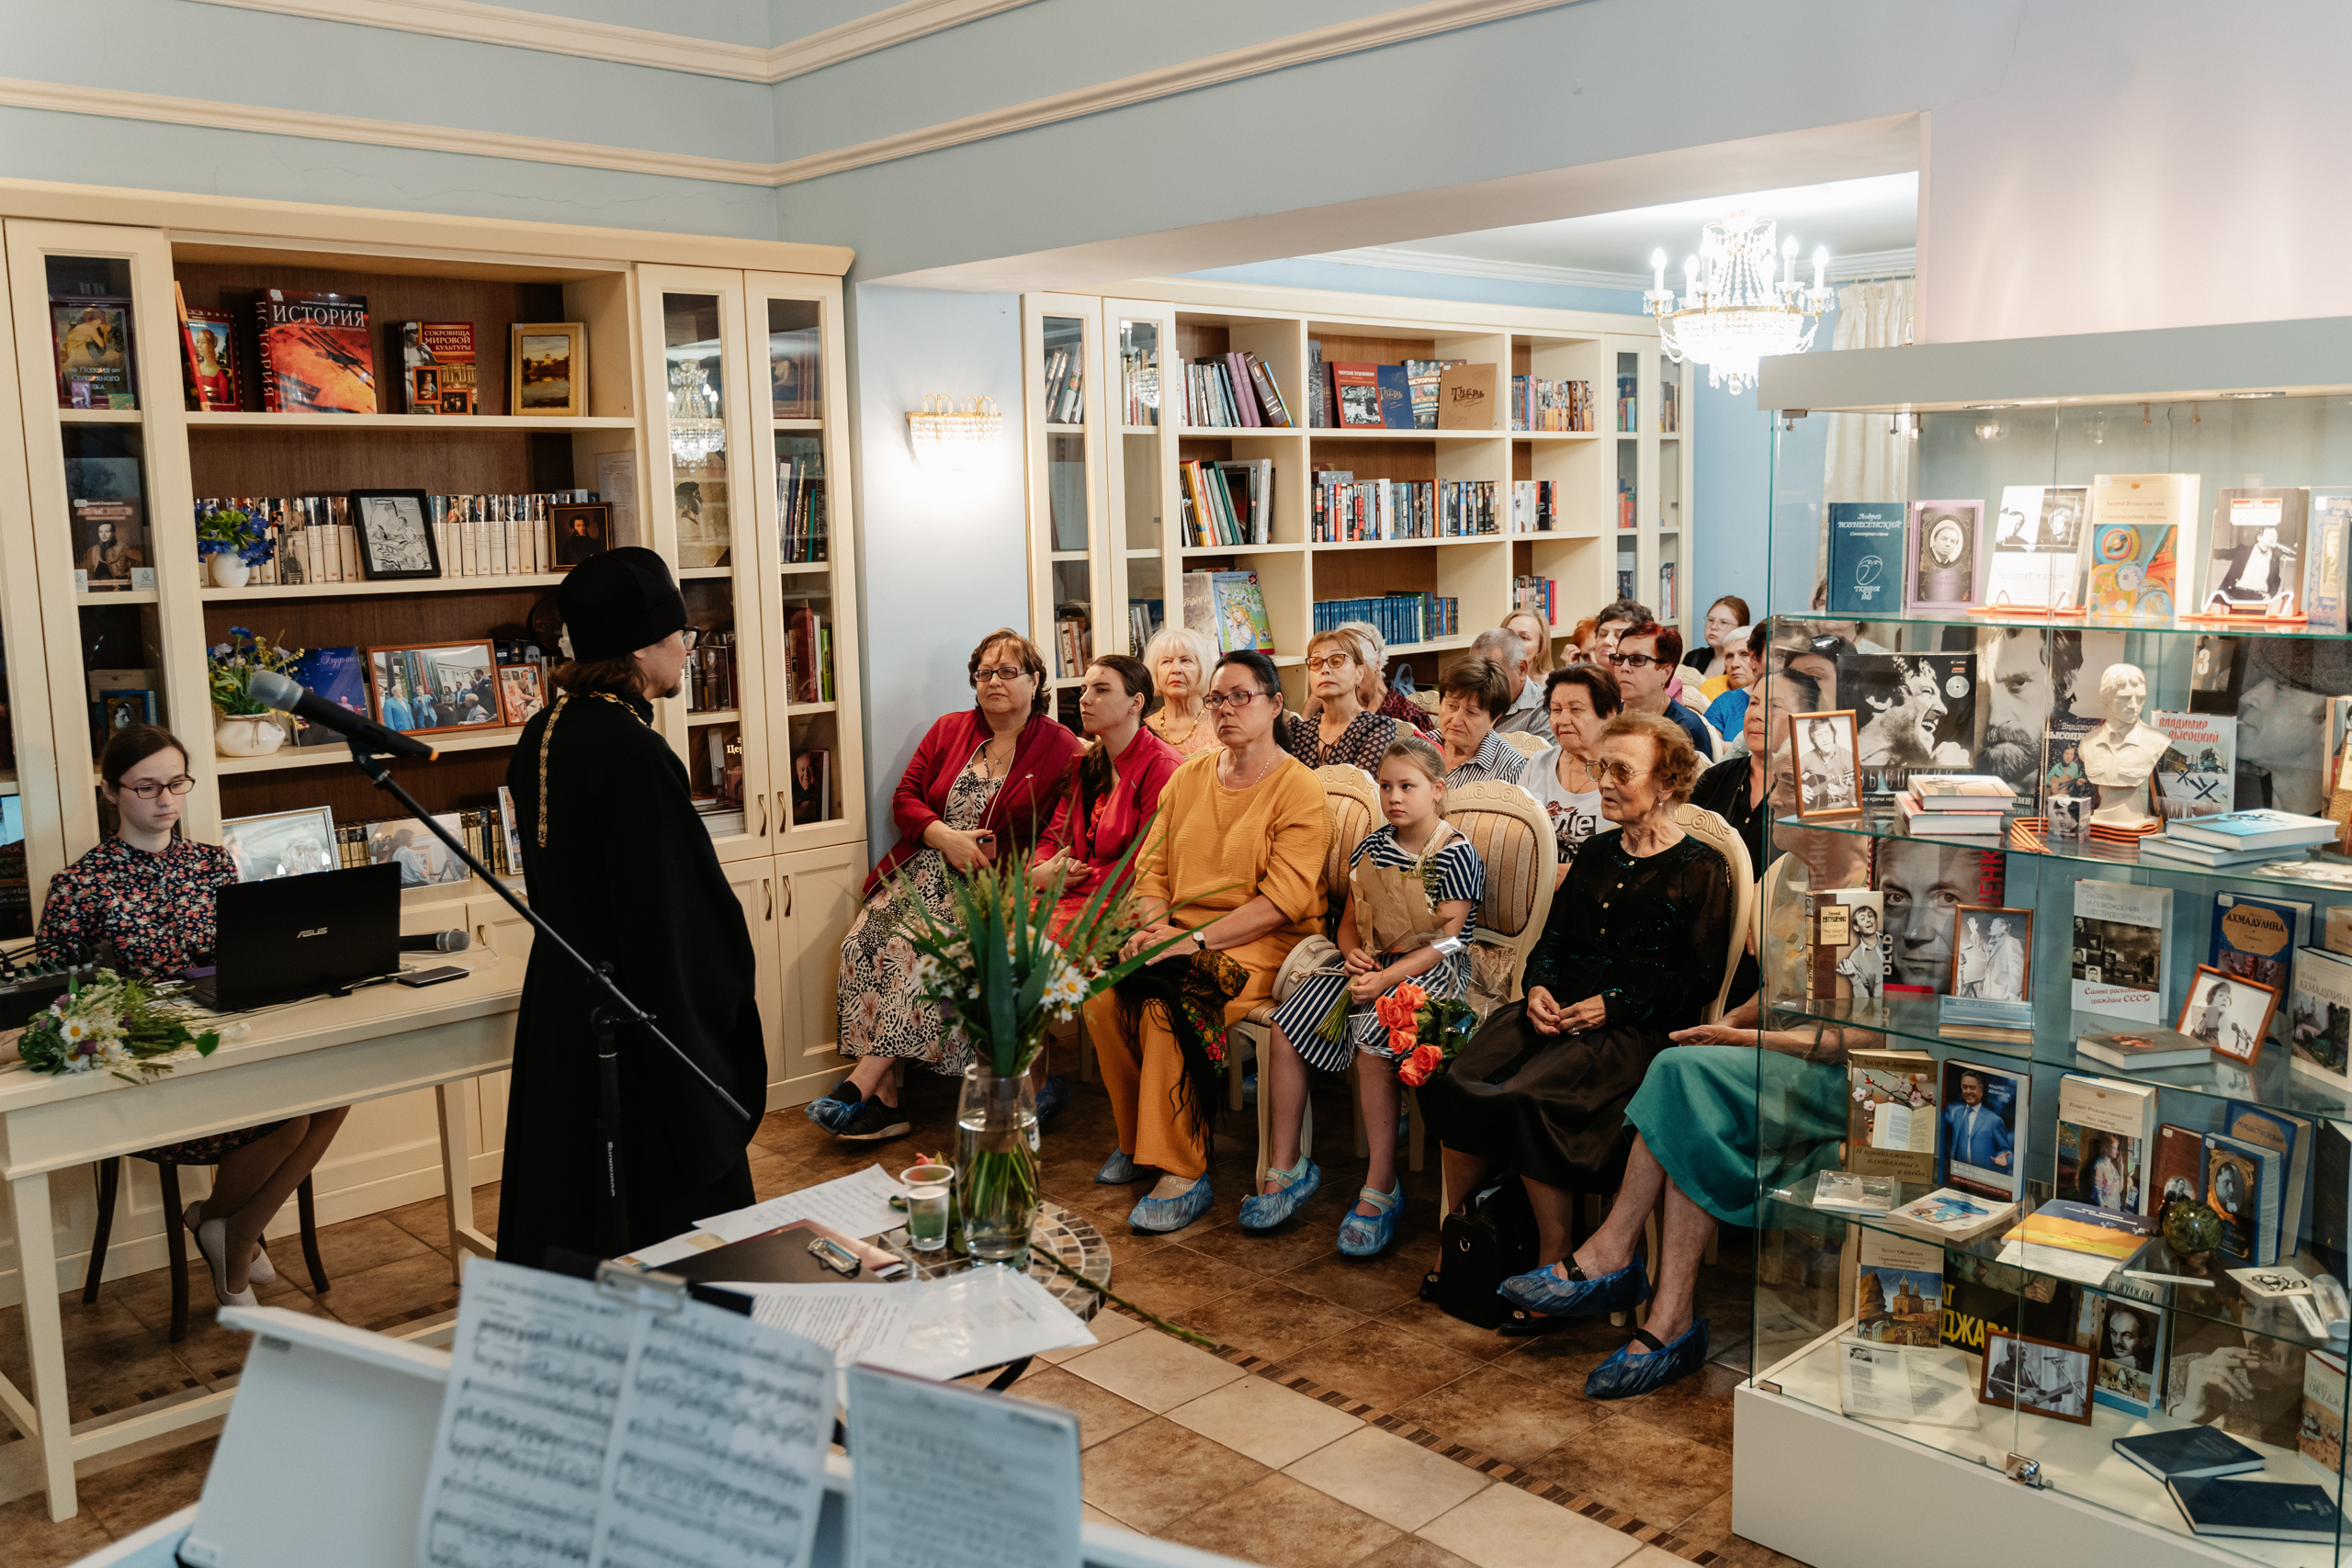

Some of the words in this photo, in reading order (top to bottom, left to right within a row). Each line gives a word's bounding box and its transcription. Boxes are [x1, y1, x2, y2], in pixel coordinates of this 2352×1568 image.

[273, 305, 366, 327] ИСТОРИЯ
[424, 331, 470, 340] СОКРОВИЩА
[424, 336, 470, 344] МИРОВОЙ
[255, 300, 275, 397] ИСТОРИЯ
[1408, 378, 1437, 386] ИСТОРИЯ
[1838, 521, 1902, 529] ВОЗНЕСЕНСКИЙ
[2159, 717, 2208, 730] ВЛАДИМИР
[2168, 731, 2220, 743] ВЫСОЦКИЙ
[2093, 900, 2139, 913] ПОХОЖДЕНИЯ
[2086, 908, 2153, 924] ШЕСТИДЕСЯТНИКОВ
[2226, 912, 2284, 932] АХМАДУЛИНА
[297, 927, 328, 938] ASUS
[2085, 987, 2108, 995] Самые
[2300, 980, 2351, 1005] АХМАДУЛИНА
[2090, 994, 2121, 1004] граждане
[2123, 994, 2150, 1003] СССР
[1863, 1059, 1889, 1068] Андрей
[1891, 1060, 1928, 1070] Дементьев
[2069, 1102, 2087, 1111] РОБЕРТ
[2088, 1106, 2133, 1121] РОЖДЕСТВЕНСКИЙ
[1864, 1150, 1914, 1160] продолжаю
[2115, 1280, 2154, 1303] ОКУДЖАВА
